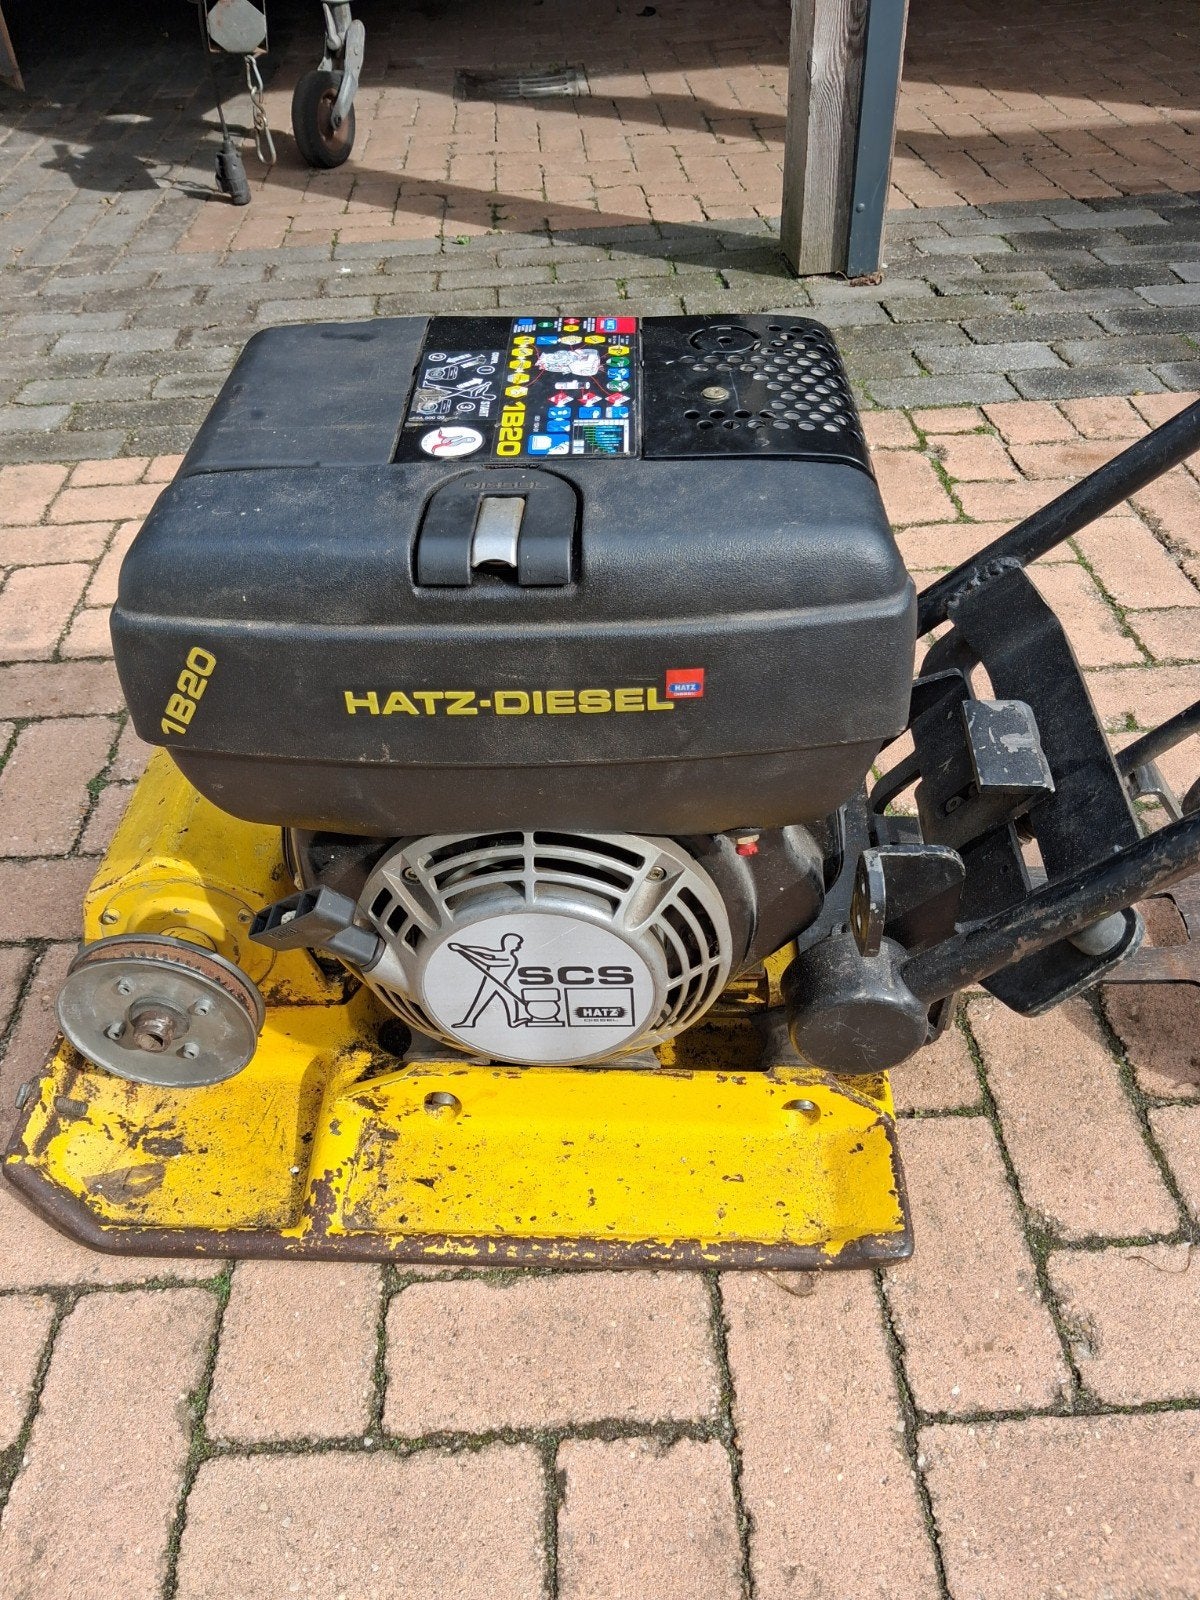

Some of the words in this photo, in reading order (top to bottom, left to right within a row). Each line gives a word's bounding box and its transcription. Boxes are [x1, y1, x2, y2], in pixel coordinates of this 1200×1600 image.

[478, 400, 491, 418] START
[496, 401, 526, 456] 1B20
[161, 646, 217, 735] 1B20
[674, 683, 697, 692] HATZ
[344, 687, 675, 716] HATZ-DIESEL
[517, 966, 635, 985] SCS
[582, 1008, 619, 1017] HATZ
